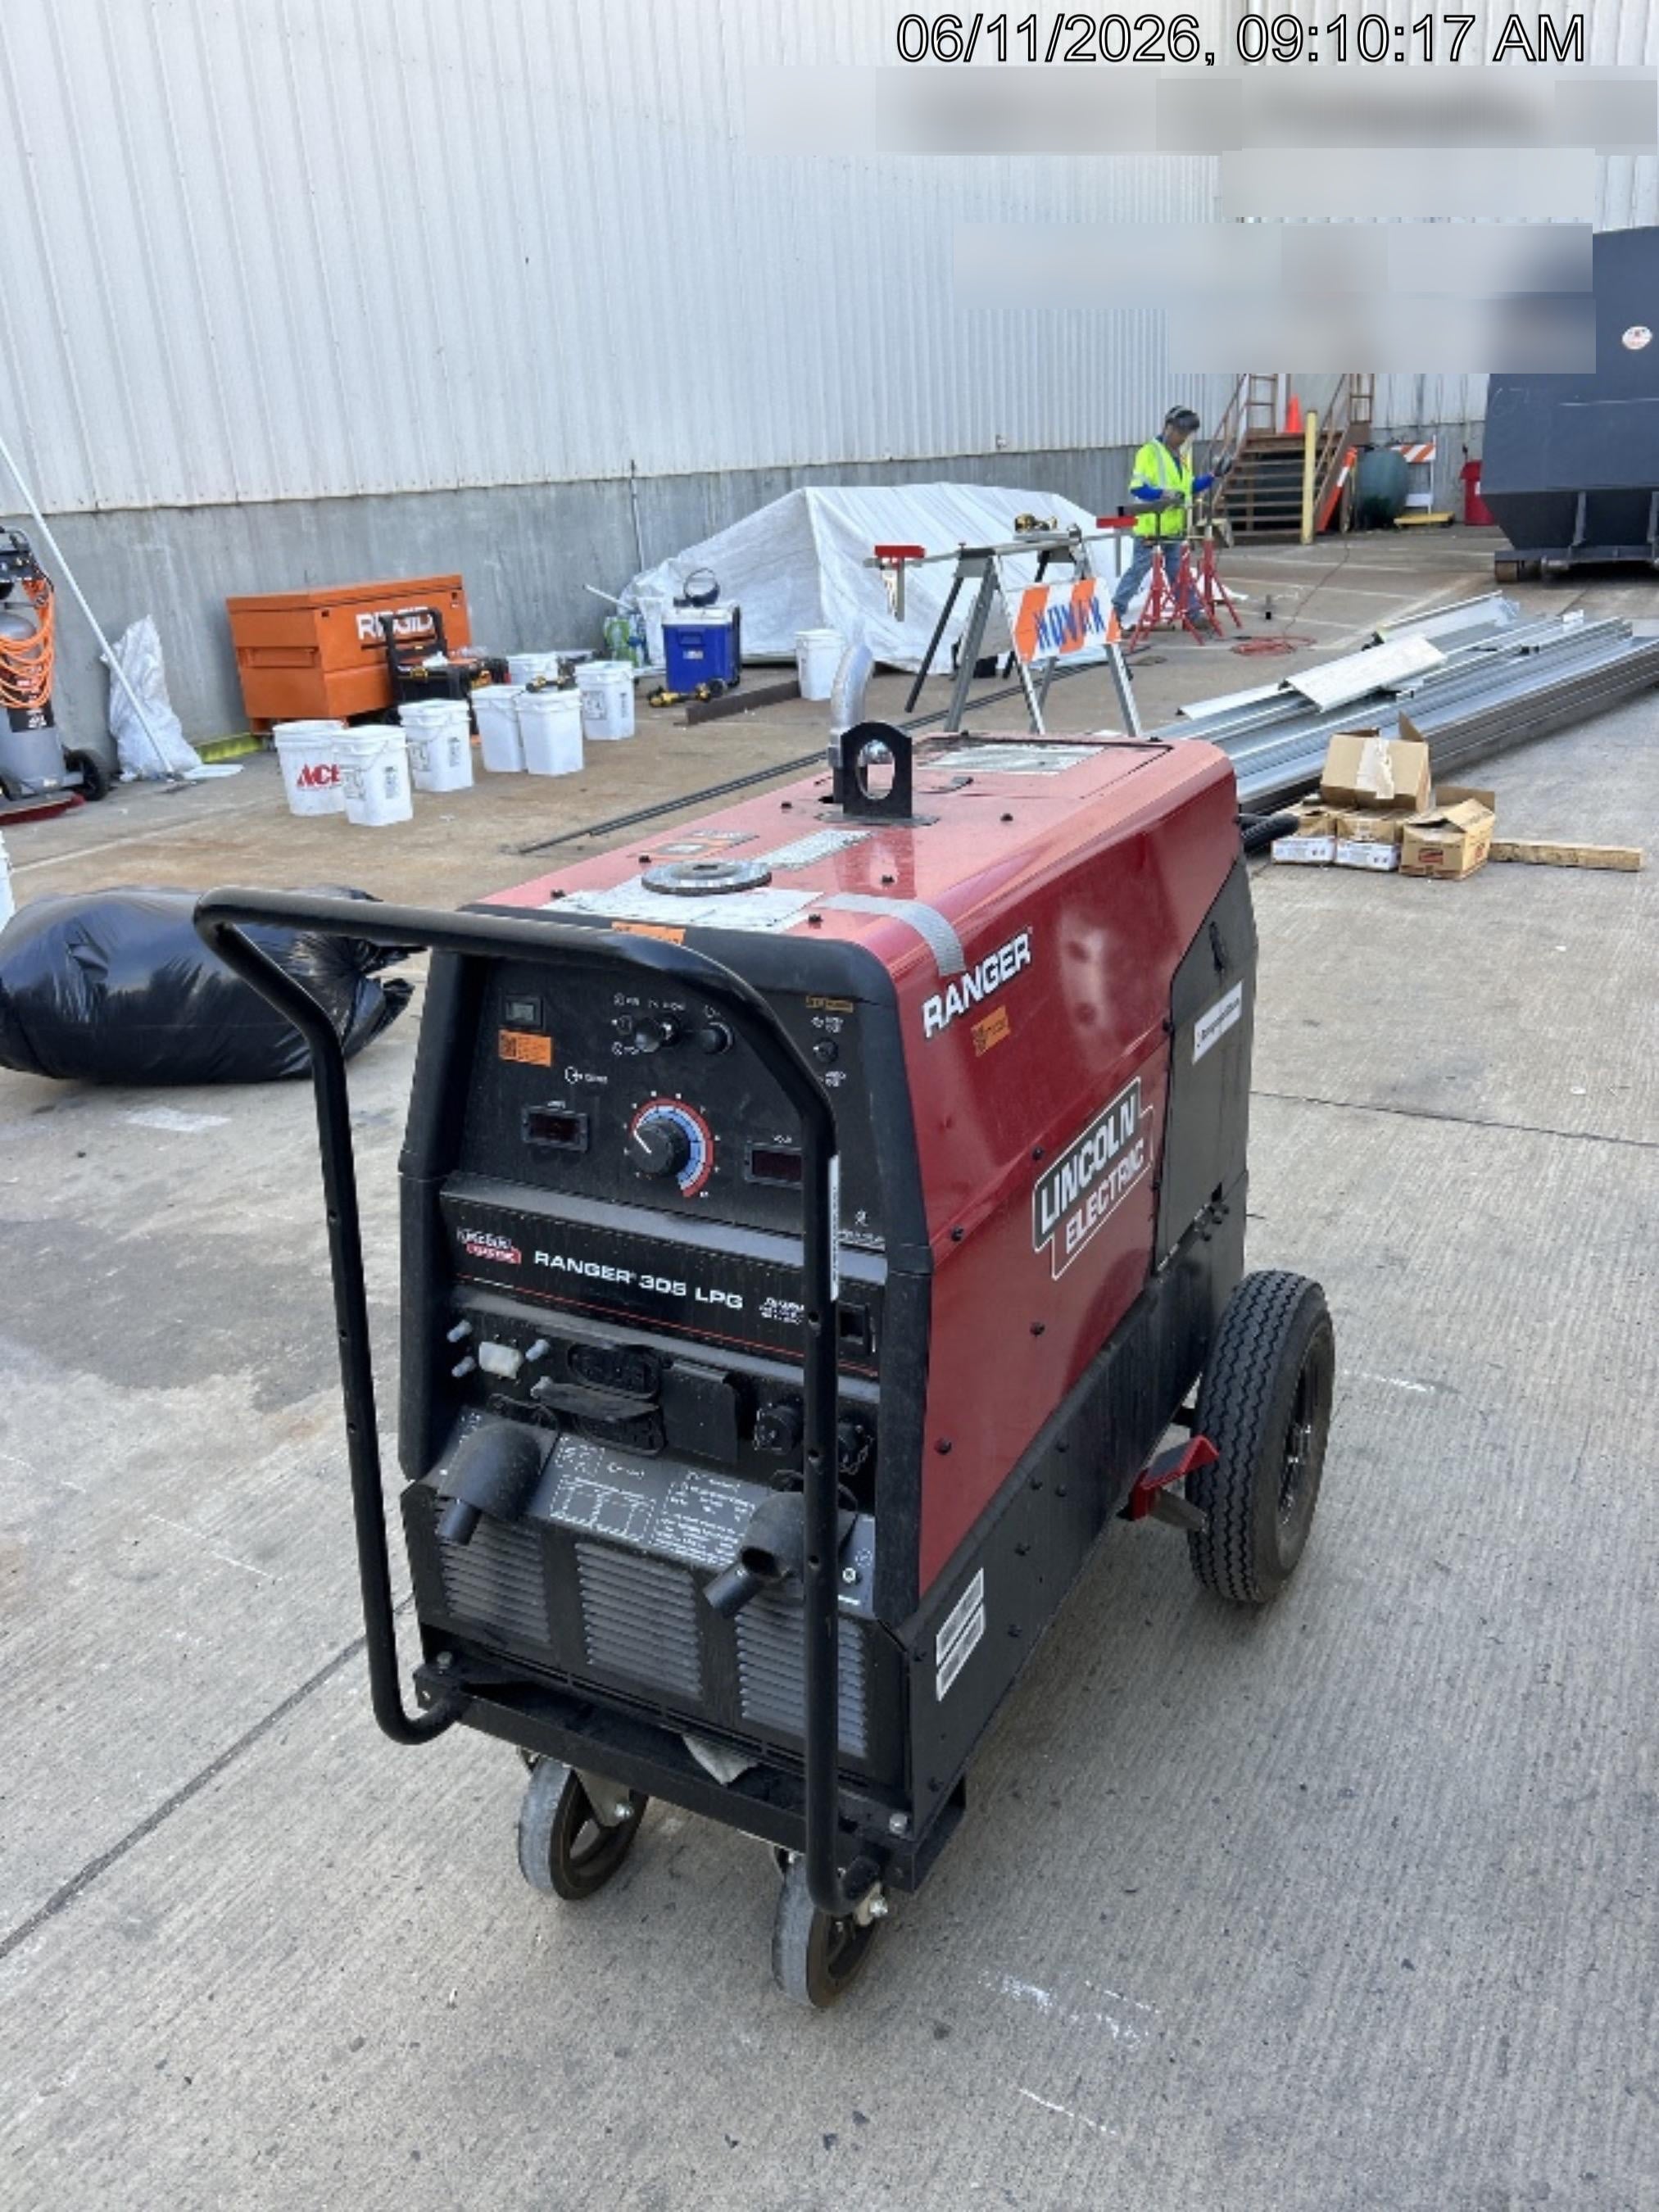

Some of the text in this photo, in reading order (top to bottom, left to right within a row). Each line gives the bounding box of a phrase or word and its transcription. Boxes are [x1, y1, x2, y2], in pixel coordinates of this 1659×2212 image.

[356, 606, 434, 640] RIGID
[923, 932, 1031, 1039] RANGER
[1041, 1095, 1136, 1235] LINCOLN
[1066, 1137, 1145, 1254] ELECTRIC
[534, 1250, 630, 1285] RANGER
[638, 1274, 687, 1297] 305
[696, 1286, 744, 1310] LPG
